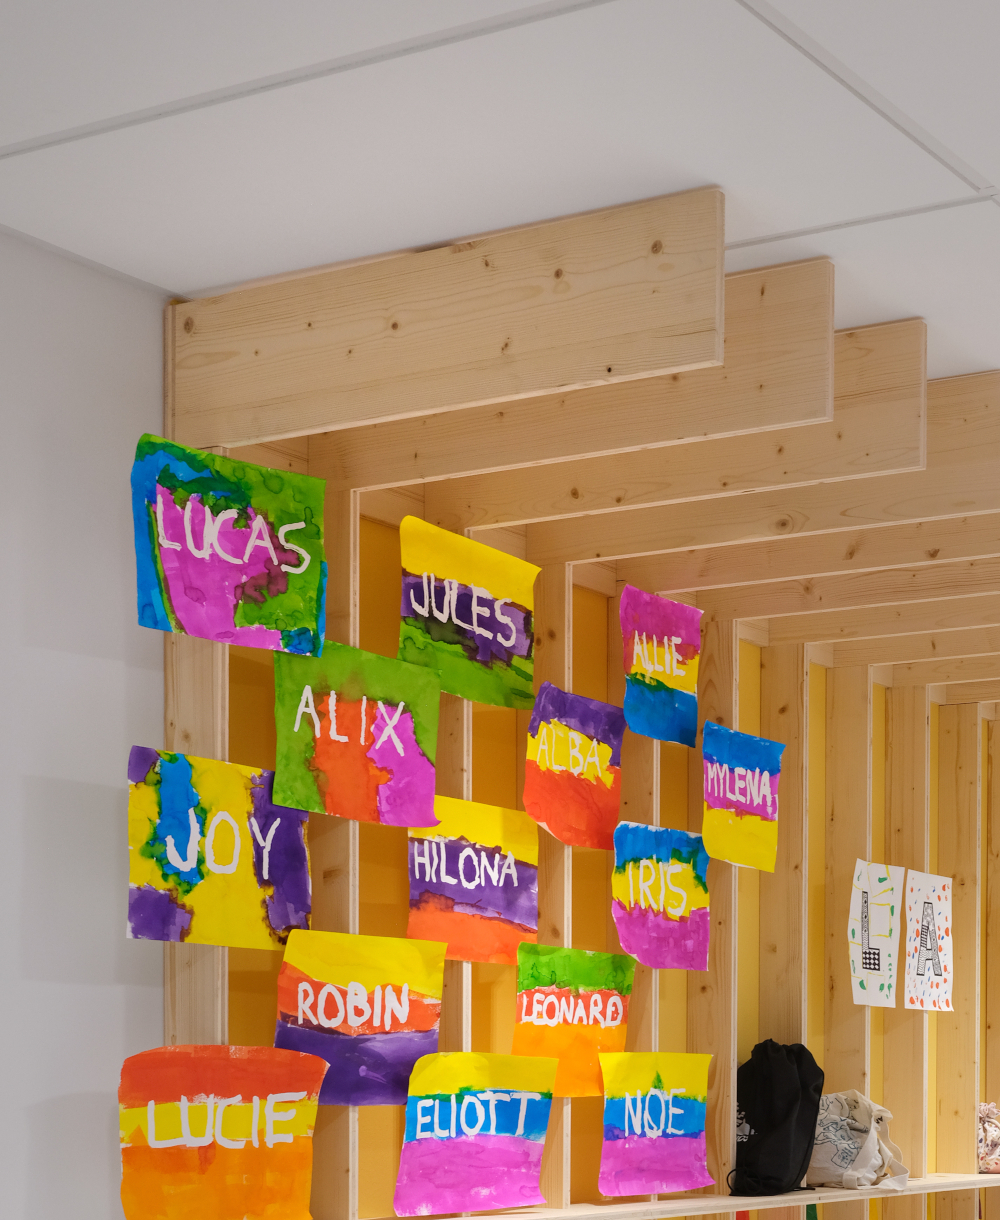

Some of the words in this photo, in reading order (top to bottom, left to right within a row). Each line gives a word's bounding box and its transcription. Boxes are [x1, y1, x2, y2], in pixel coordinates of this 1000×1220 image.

[156, 494, 311, 574] LUCAS
[409, 571, 517, 647] JULES
[294, 684, 406, 757] ALIX
[536, 735, 602, 780] ALBA
[706, 764, 772, 807] MYLENA
[165, 807, 281, 881] JOY
[412, 839, 519, 890] HILONA
[628, 858, 688, 914] IRIS
[861, 891, 942, 976] LA
[297, 982, 410, 1031] ROBIN
[521, 993, 624, 1028] LEONARD
[146, 1091, 308, 1149] LUCIE
[416, 1091, 542, 1139] ELIOTT
